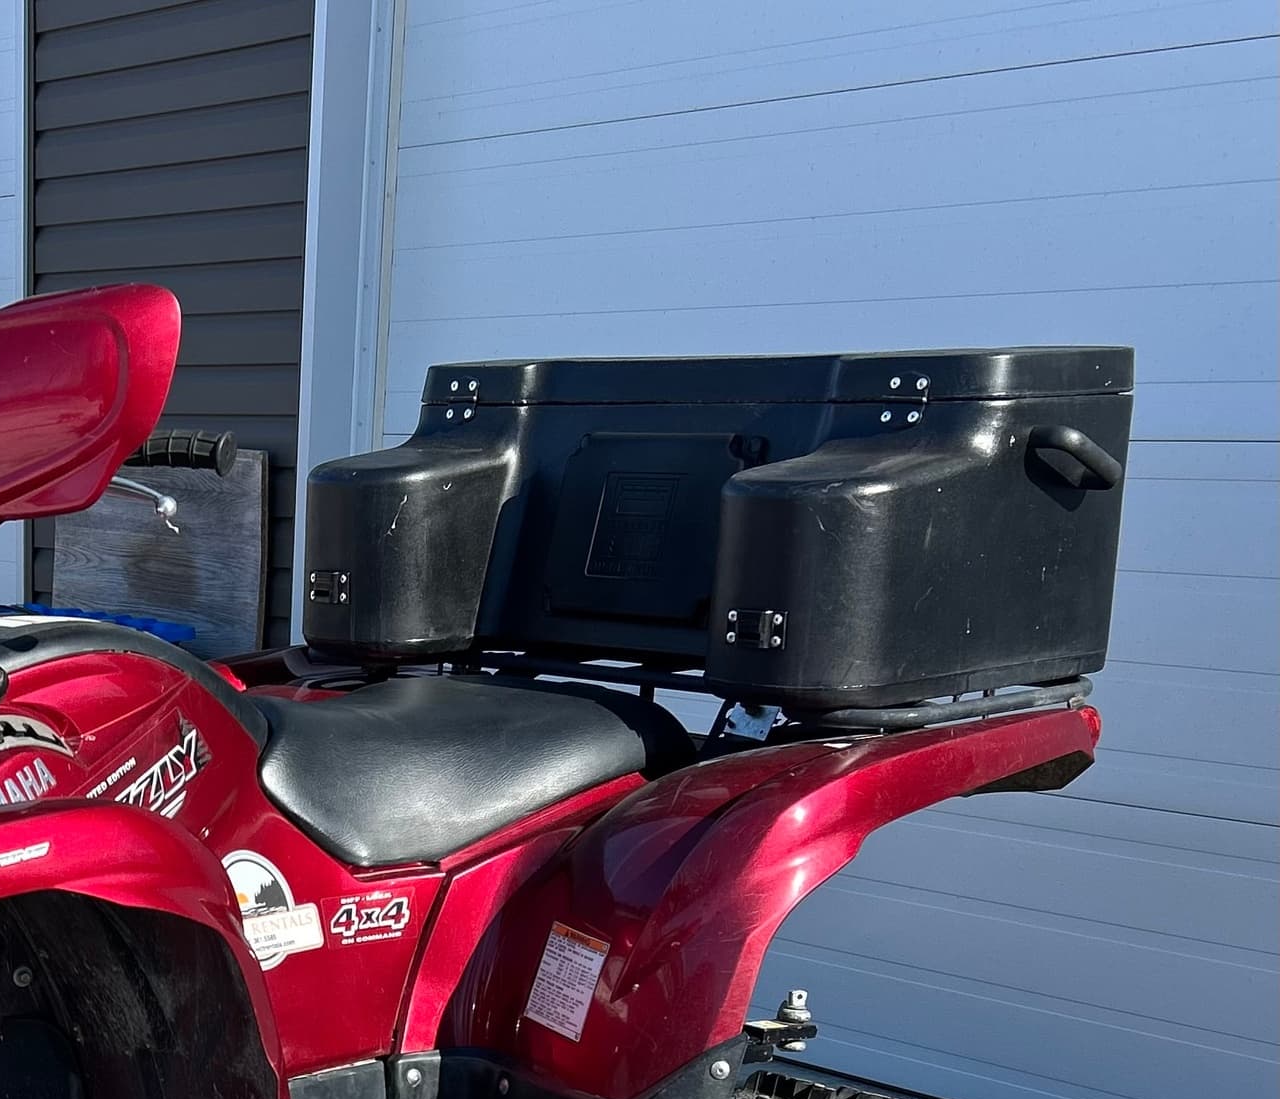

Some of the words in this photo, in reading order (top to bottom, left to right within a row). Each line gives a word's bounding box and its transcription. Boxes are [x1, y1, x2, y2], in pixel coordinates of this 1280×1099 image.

[106, 756, 137, 787] EDITION
[251, 911, 314, 936] RENTALS
[341, 936, 356, 945] ON
[356, 931, 403, 944] COMMAND
